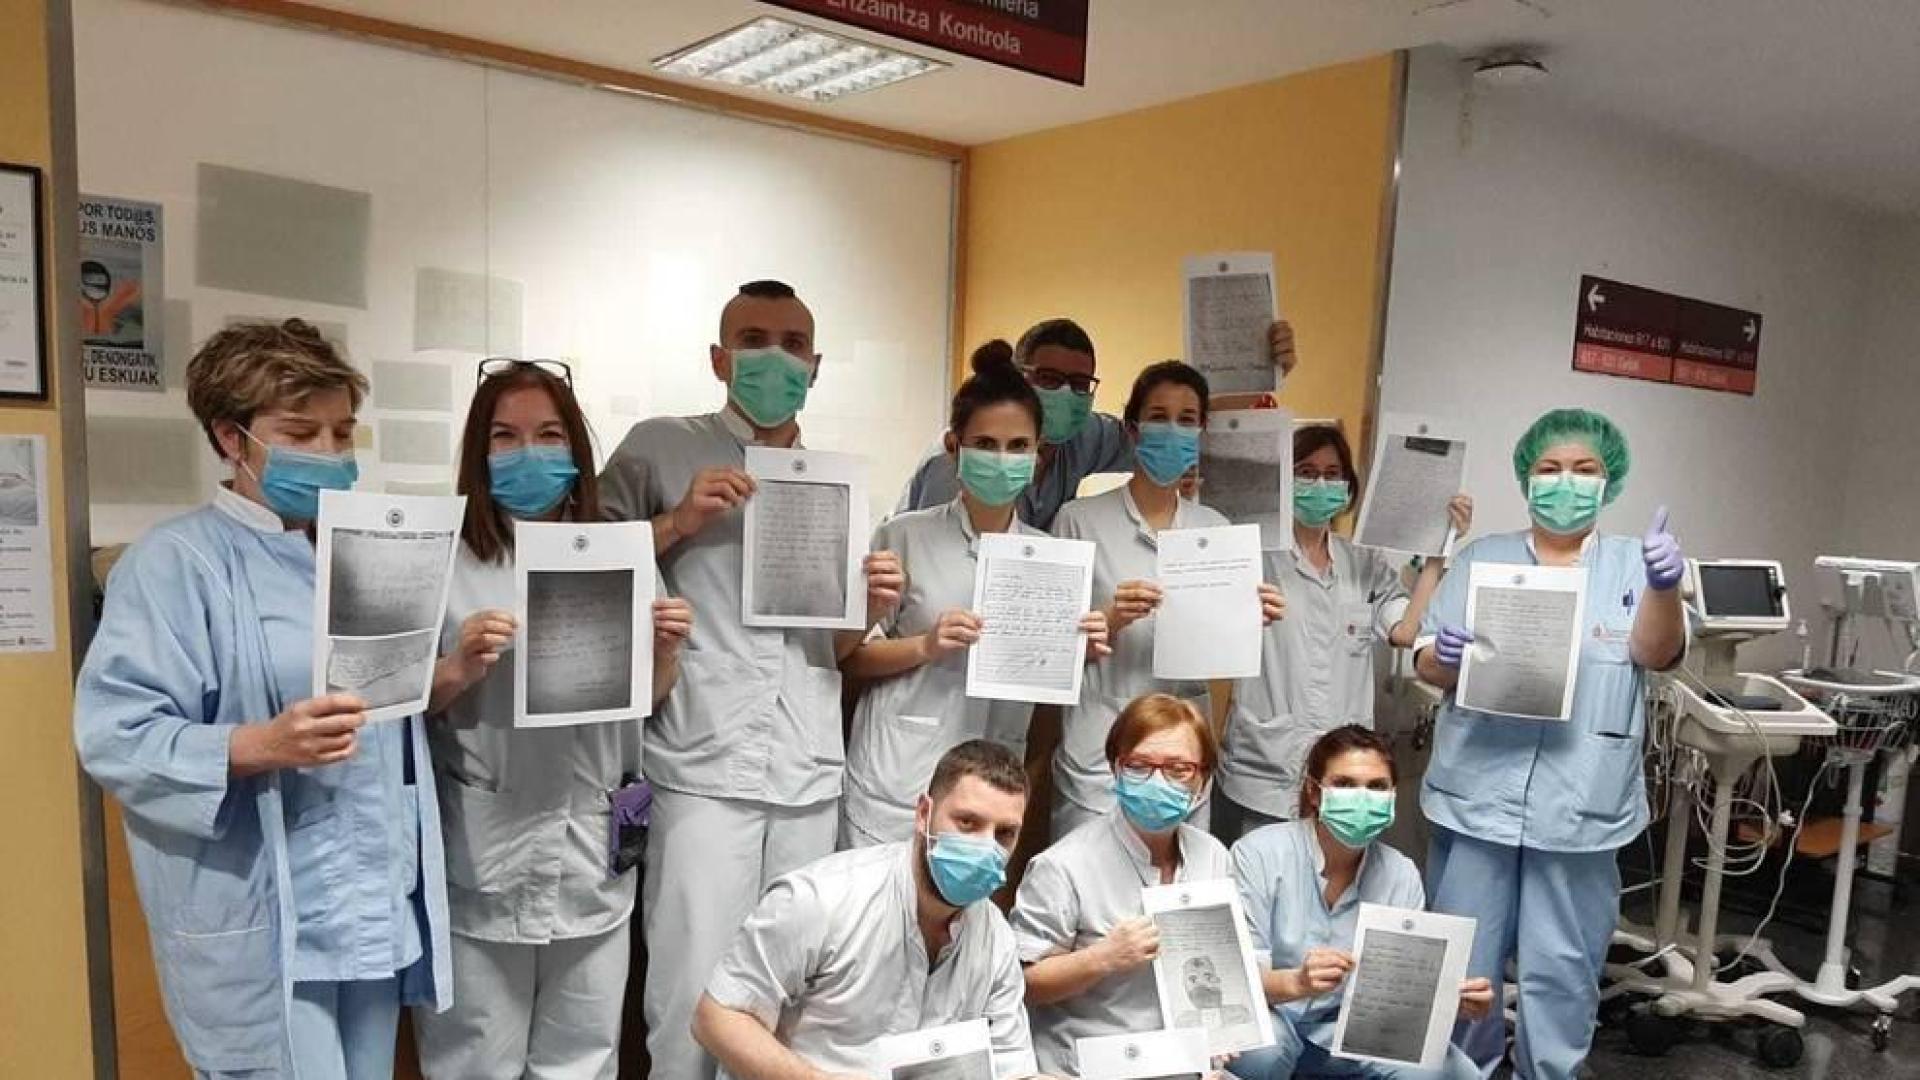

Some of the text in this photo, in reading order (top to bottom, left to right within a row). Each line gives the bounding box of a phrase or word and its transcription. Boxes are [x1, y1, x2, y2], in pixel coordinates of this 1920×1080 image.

[939, 11, 1021, 54] Kontrola
[102, 223, 155, 242] MANOS
[99, 367, 159, 385] ESKUAK
